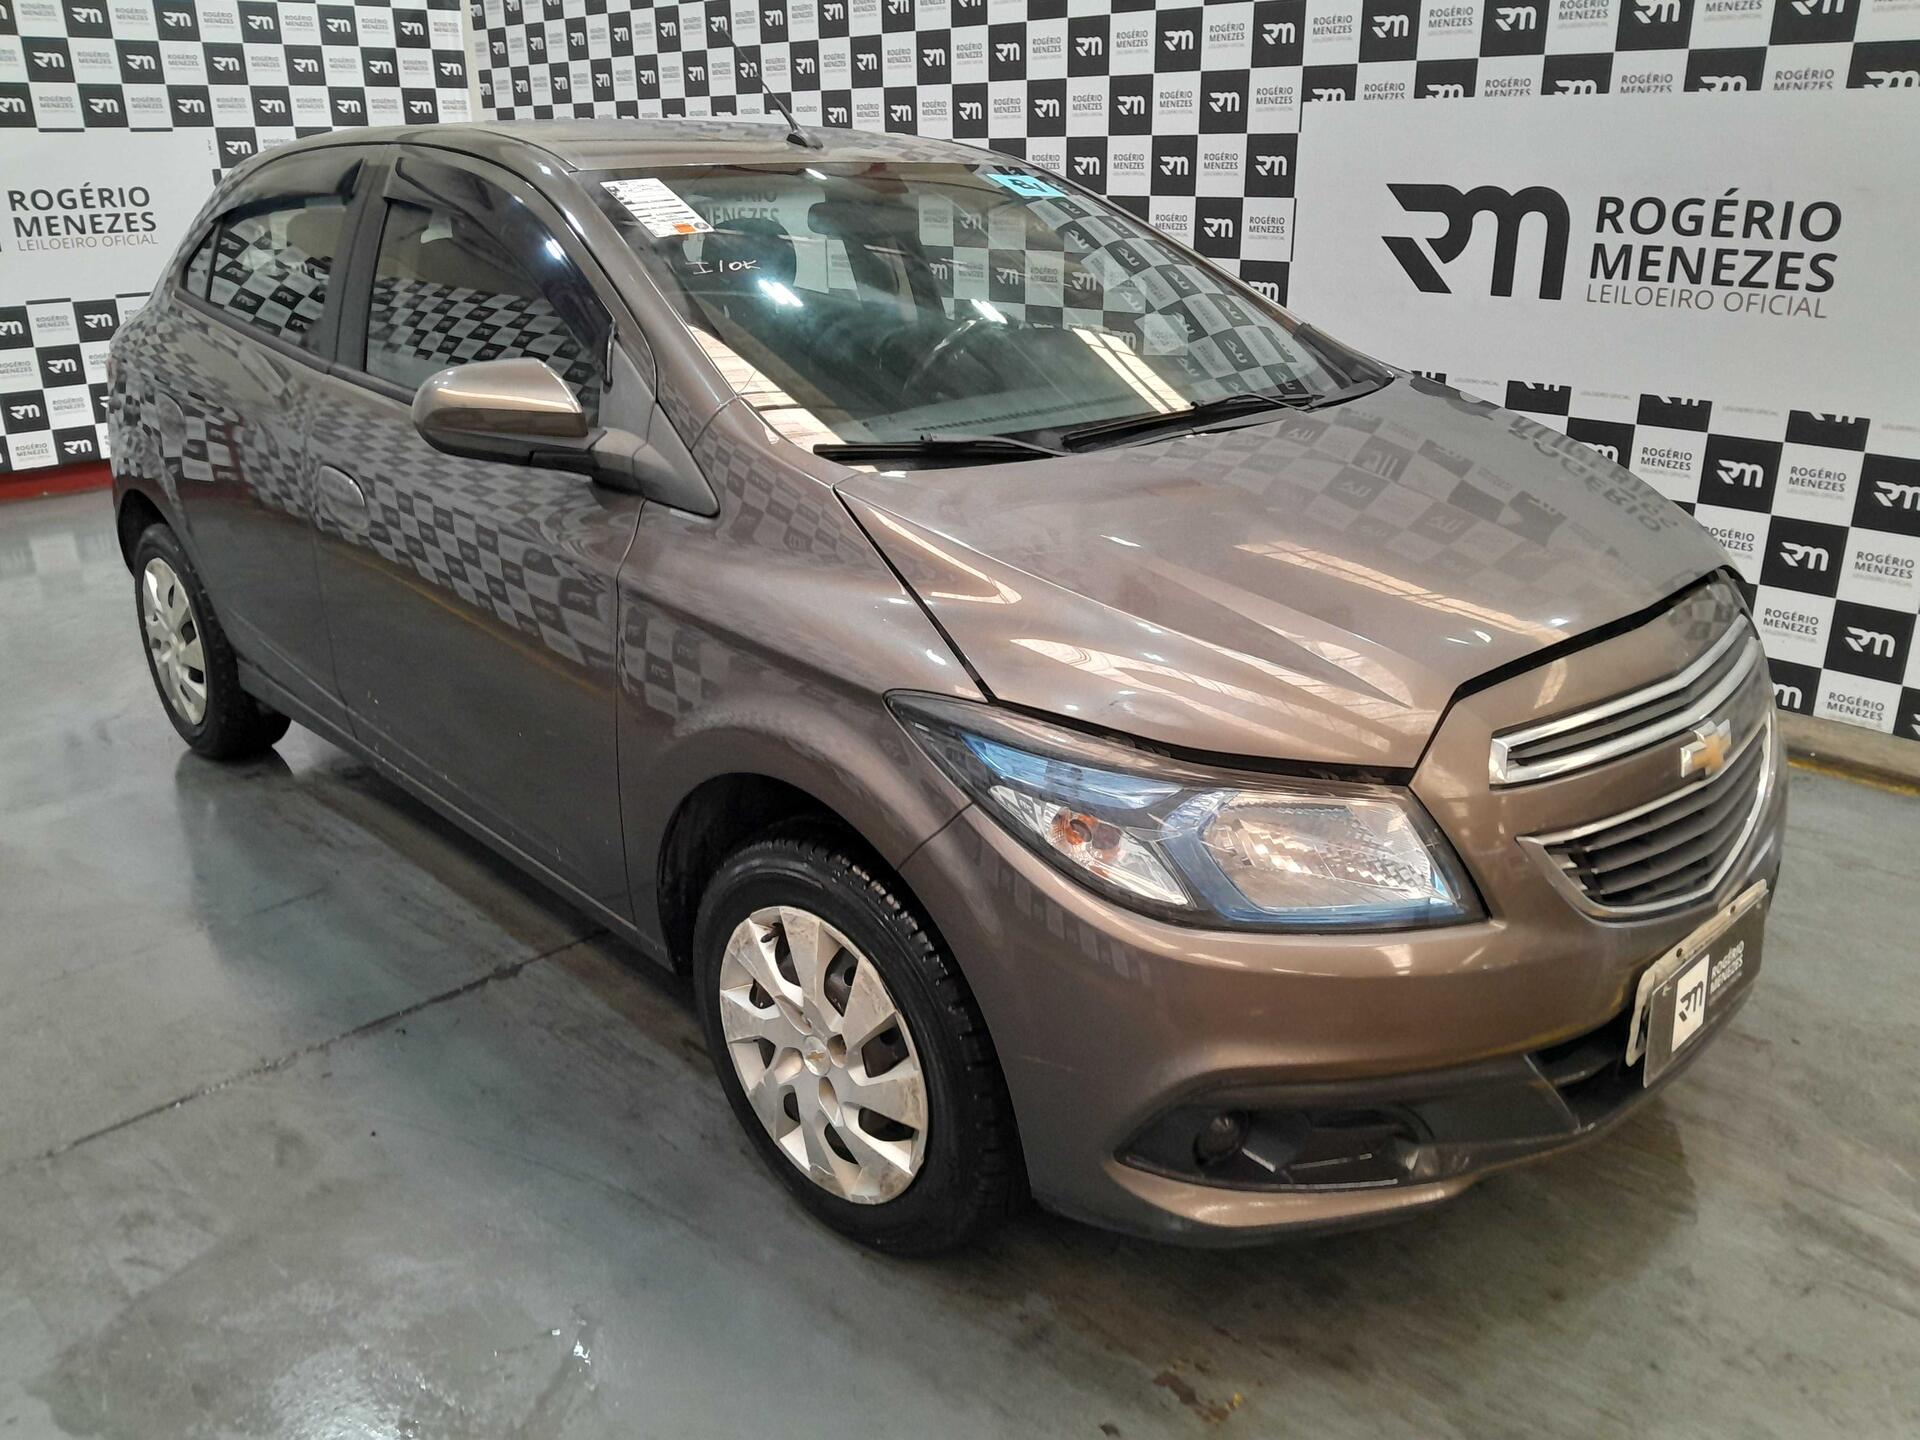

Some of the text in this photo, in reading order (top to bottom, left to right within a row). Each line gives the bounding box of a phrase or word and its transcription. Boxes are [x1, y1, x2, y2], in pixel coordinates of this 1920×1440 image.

[1429, 6, 1473, 18] ROGÉRIO
[1559, 10, 1608, 20] MENEZES
[1313, 14, 1352, 25] ROGÉRIO
[1428, 18, 1473, 28] MENEZES
[1210, 22, 1244, 32] ROGÉRIO
[1312, 25, 1352, 35] MENEZES
[1116, 30, 1148, 39] ROGÉRIO
[1210, 32, 1244, 42] MENEZES
[1032, 35, 1061, 46] ROGÉRIO
[1116, 39, 1148, 48] MENEZES
[1032, 45, 1061, 53] MENEZES
[1621, 72, 1672, 84] ROGÉRIO
[1775, 68, 1834, 80] ROGÉRIO
[1364, 81, 1404, 92] ROGÉRIO
[1486, 77, 1532, 88] ROGÉRIO
[1160, 90, 1192, 99] ROGÉRIO
[1256, 86, 1292, 96] ROGÉRIO
[1072, 94, 1102, 102] ROGÉRIO
[1256, 96, 1292, 104] MENEZES
[1072, 102, 1102, 111] MENEZES
[1160, 100, 1192, 108] MENEZES
[1113, 152, 1144, 162] ROGÉRIO
[1204, 152, 1238, 162] ROGÉRIO
[1113, 162, 1144, 170] MENEZES
[1204, 162, 1238, 170] MENEZES
[8, 182, 150, 211] ROGÉRIO
[1156, 213, 1188, 222] ROGÉRIO
[1250, 215, 1285, 225] ROGÉRIO
[1595, 188, 1842, 242] ROGÉRIO
[13, 211, 157, 238] MENEZES
[1249, 224, 1285, 234] MENEZES
[17, 233, 158, 251] LEILOEIRO OFICIAL
[1590, 244, 1838, 292] MENEZES
[1586, 284, 1826, 318] LEILOEIRO OFICIAL
[1642, 446, 1692, 461] ROGÉRIO
[1640, 456, 1691, 471] MENEZES
[1790, 466, 1847, 482] ROGÉRIO
[1788, 476, 1846, 492] MENEZES
[1856, 551, 1914, 568] ROGÉRIO
[1854, 562, 1913, 579] MENEZES
[1765, 608, 1819, 626] ROGÉRIO
[1763, 618, 1818, 636] MENEZES
[1828, 692, 1884, 712] ROGÉRIO
[1827, 702, 1883, 722] MENEZES
[1712, 940, 1744, 976] ROGÉRIO
[1710, 954, 1744, 992] MENEZES
